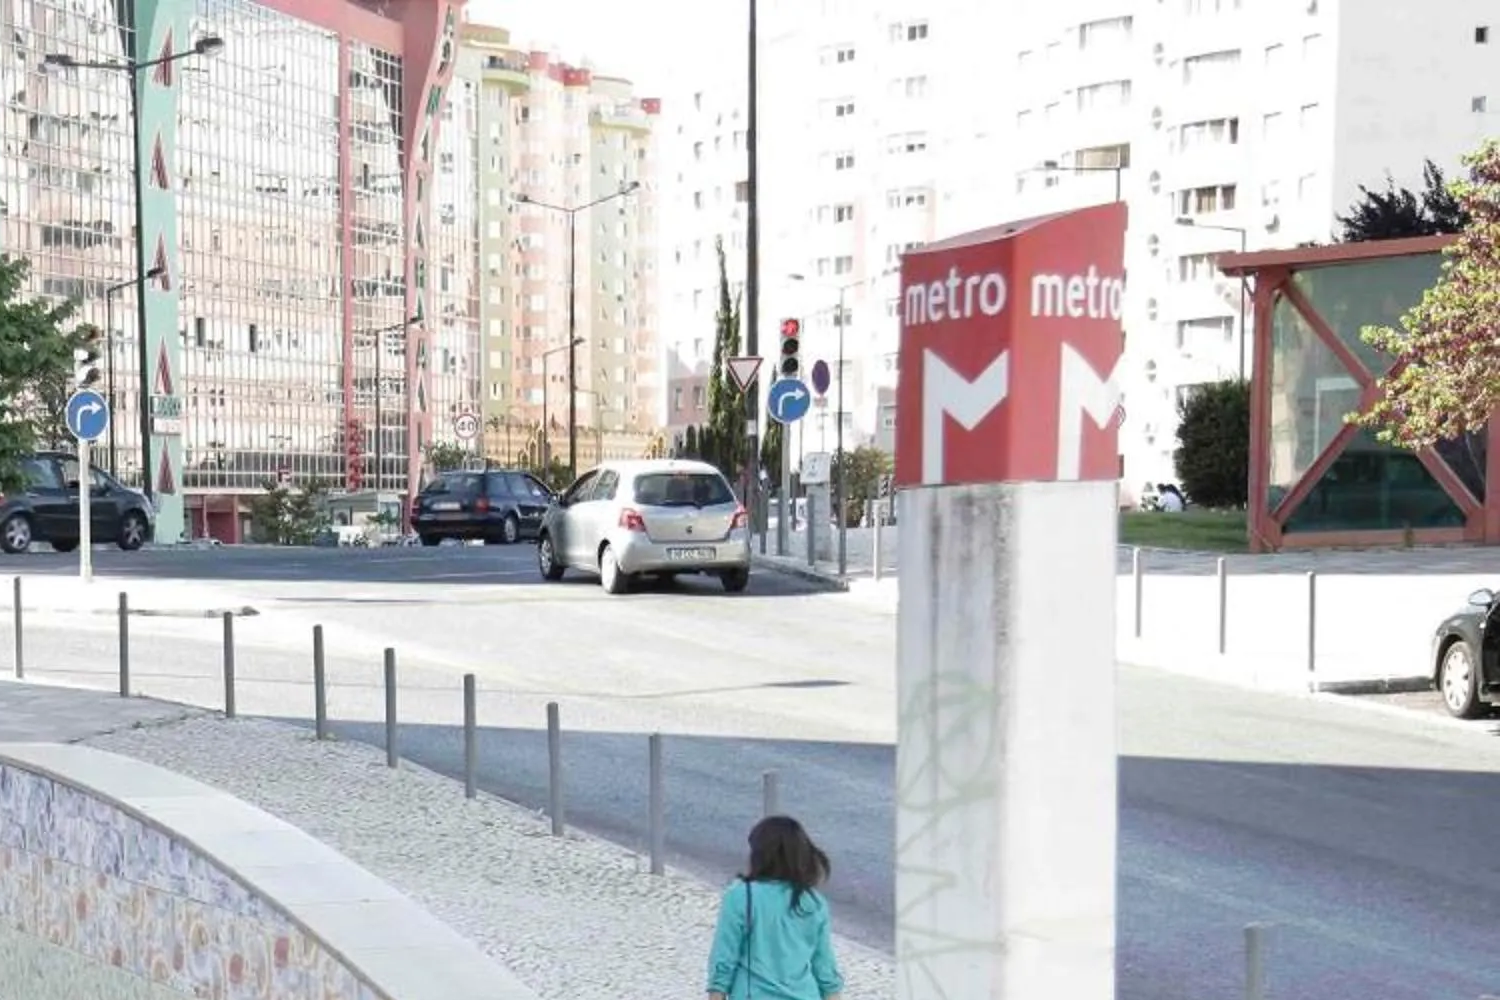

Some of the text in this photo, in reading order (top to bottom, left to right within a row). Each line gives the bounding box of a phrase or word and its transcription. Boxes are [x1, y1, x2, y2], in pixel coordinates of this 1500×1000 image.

[905, 265, 1008, 327] metro
[1030, 264, 1124, 321] metro
[458, 421, 475, 432] 40
